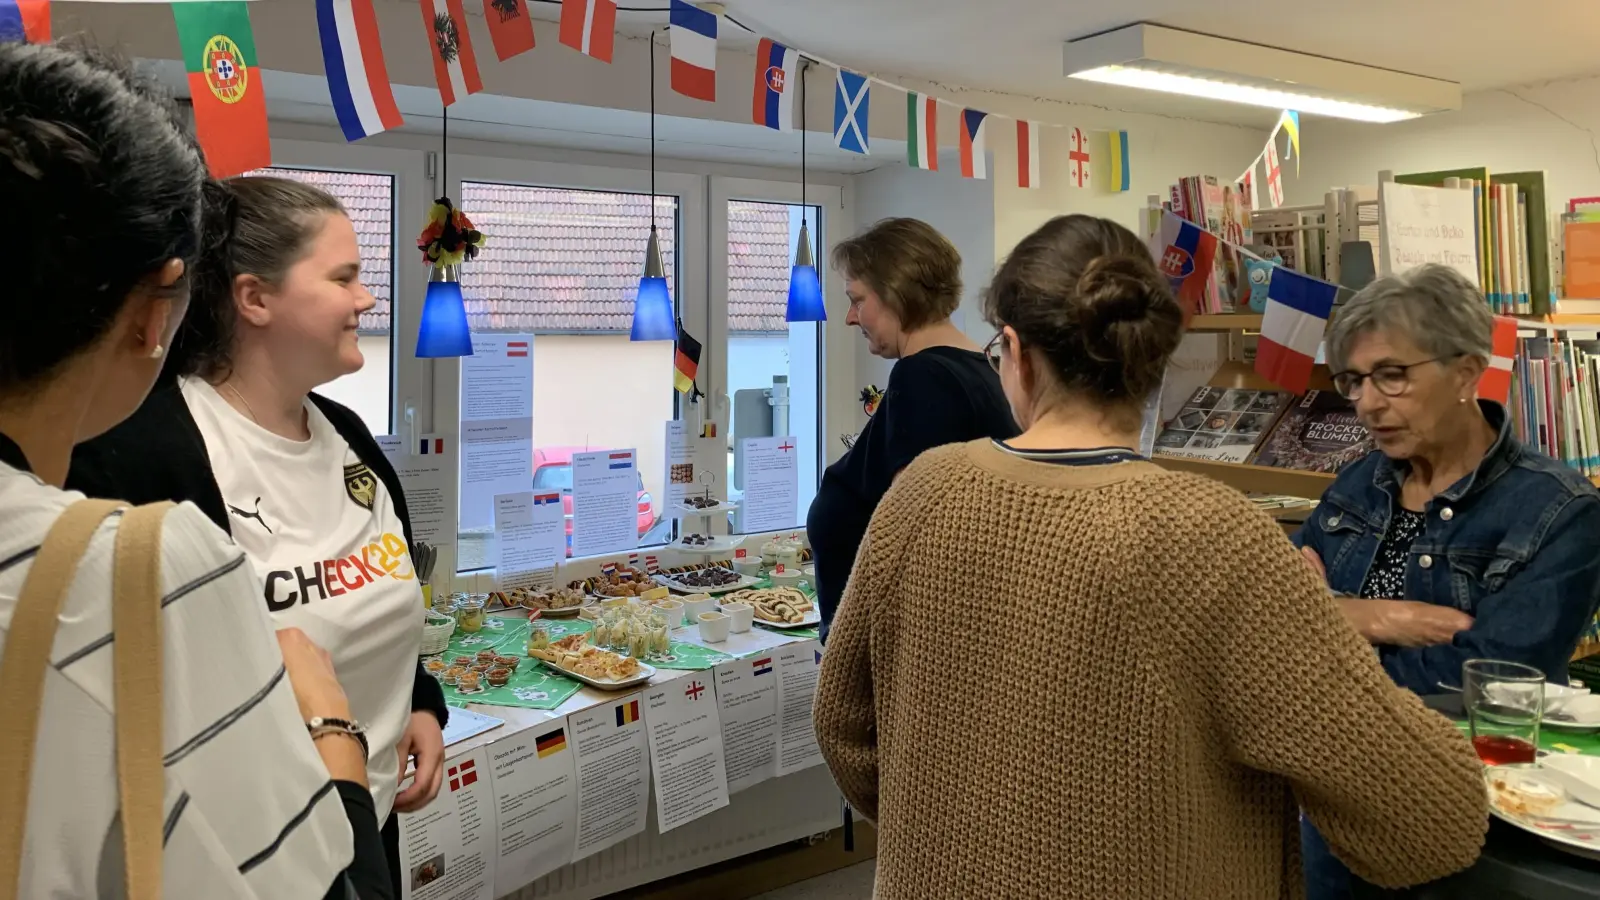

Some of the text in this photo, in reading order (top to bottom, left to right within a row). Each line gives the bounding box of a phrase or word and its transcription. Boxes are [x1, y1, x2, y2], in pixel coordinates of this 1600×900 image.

[1172, 186, 1181, 210] TOPP
[1306, 430, 1361, 442] BLUMEN
[1309, 422, 1368, 434] TROCKEN
[264, 533, 409, 612] CHECK24
